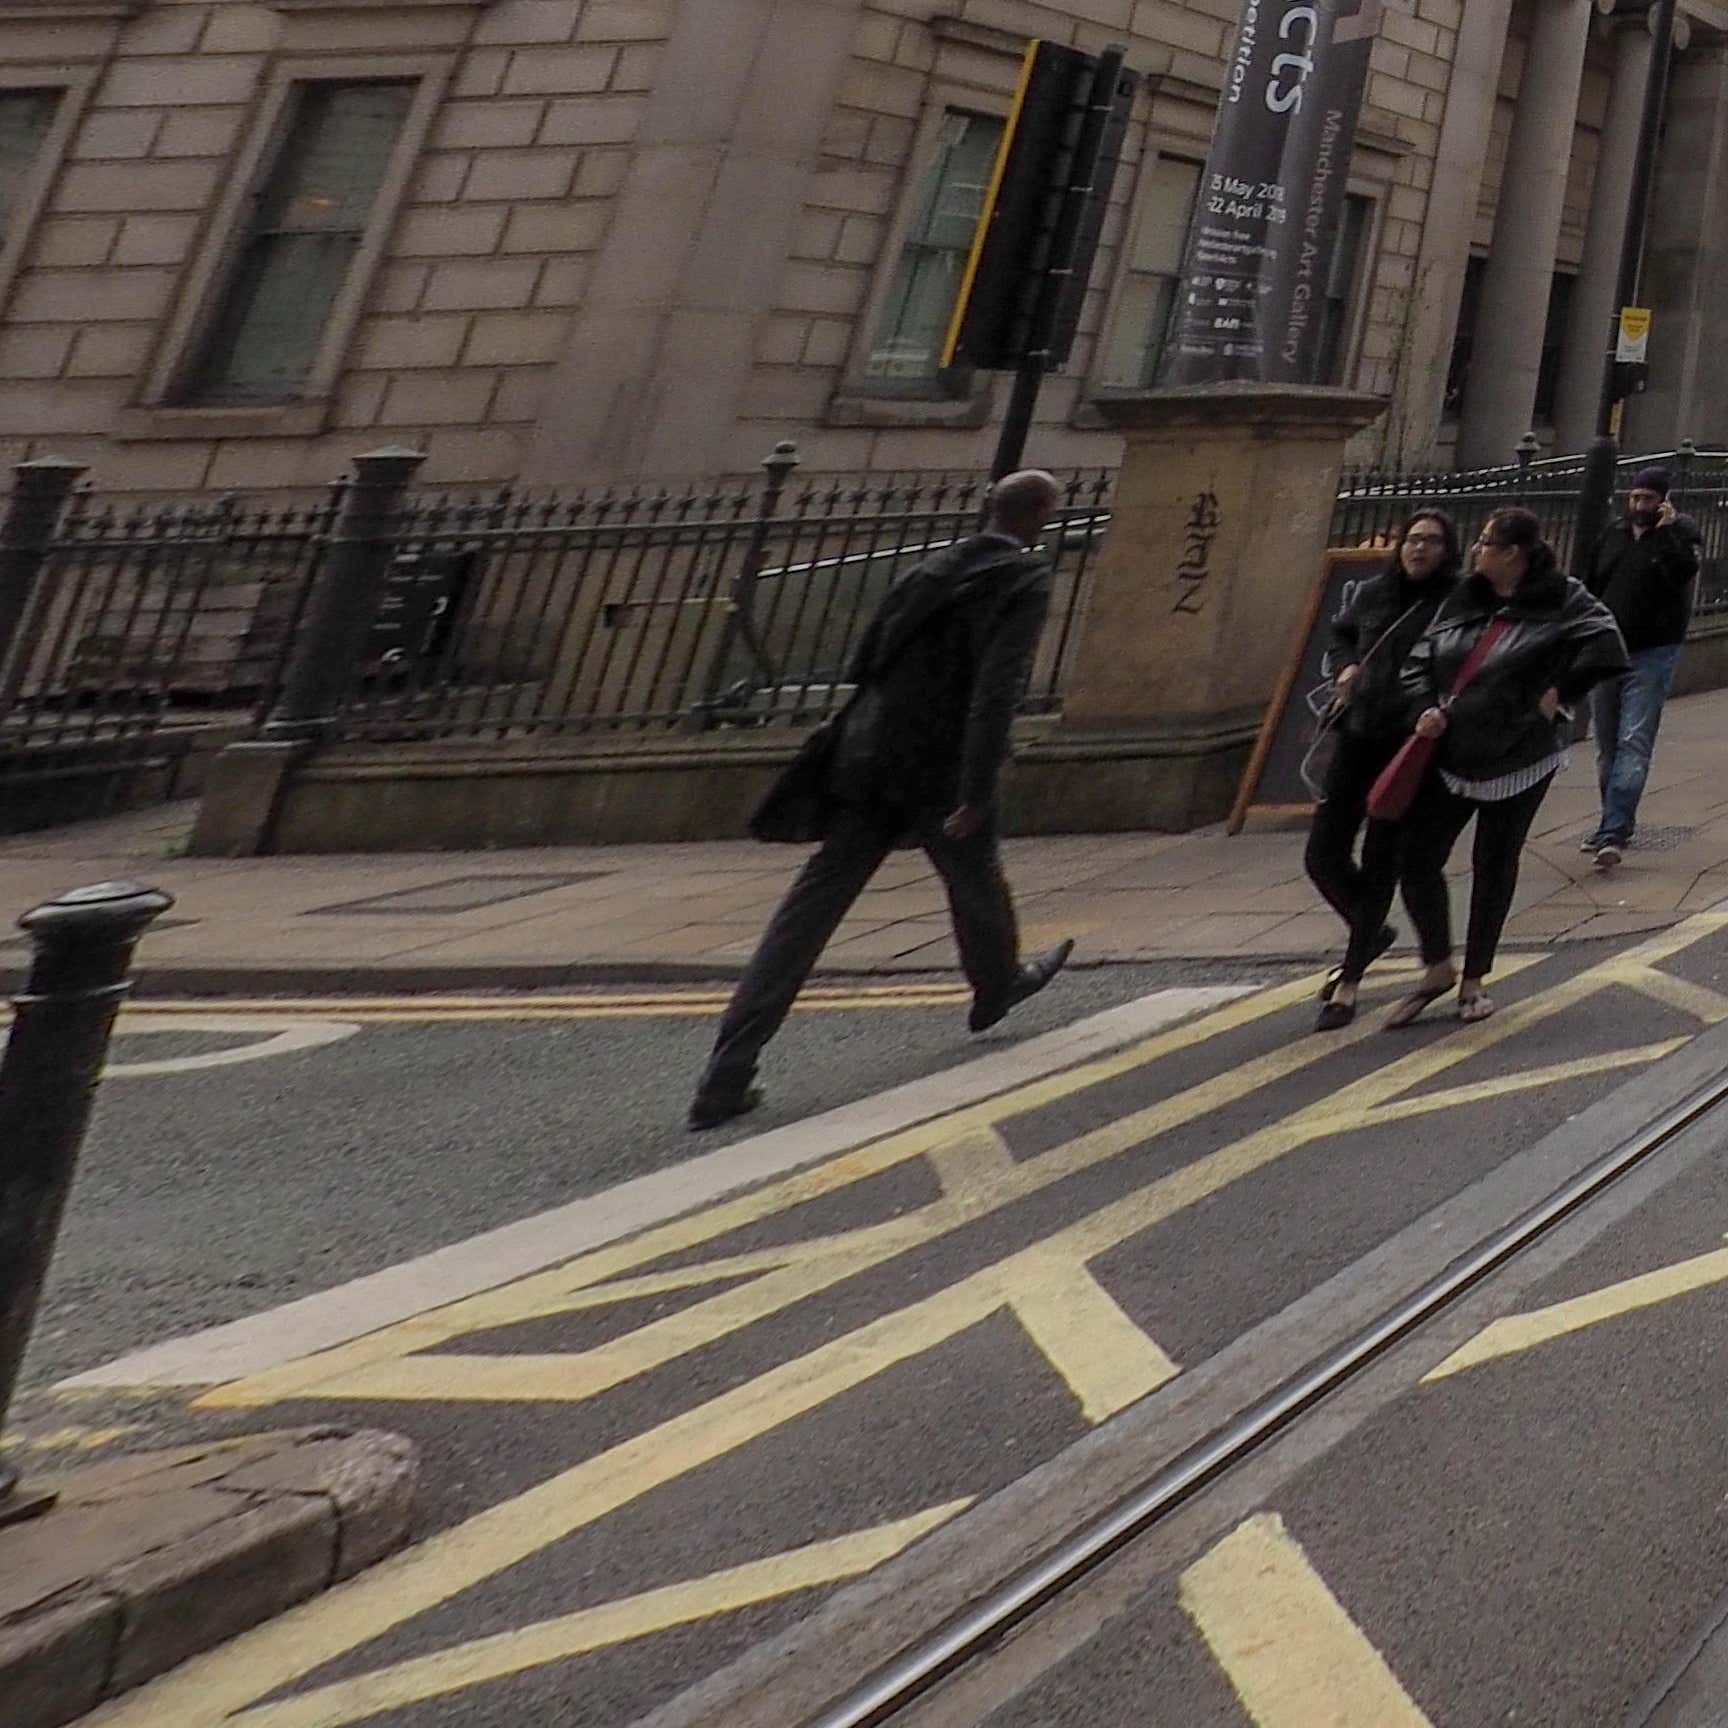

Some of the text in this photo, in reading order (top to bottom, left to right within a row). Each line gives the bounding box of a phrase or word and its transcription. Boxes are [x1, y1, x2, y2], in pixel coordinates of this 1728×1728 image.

[1225, 176, 1254, 200] May
[1225, 199, 1262, 219] April
[1281, 109, 1343, 364] Manchester Art Gallery
